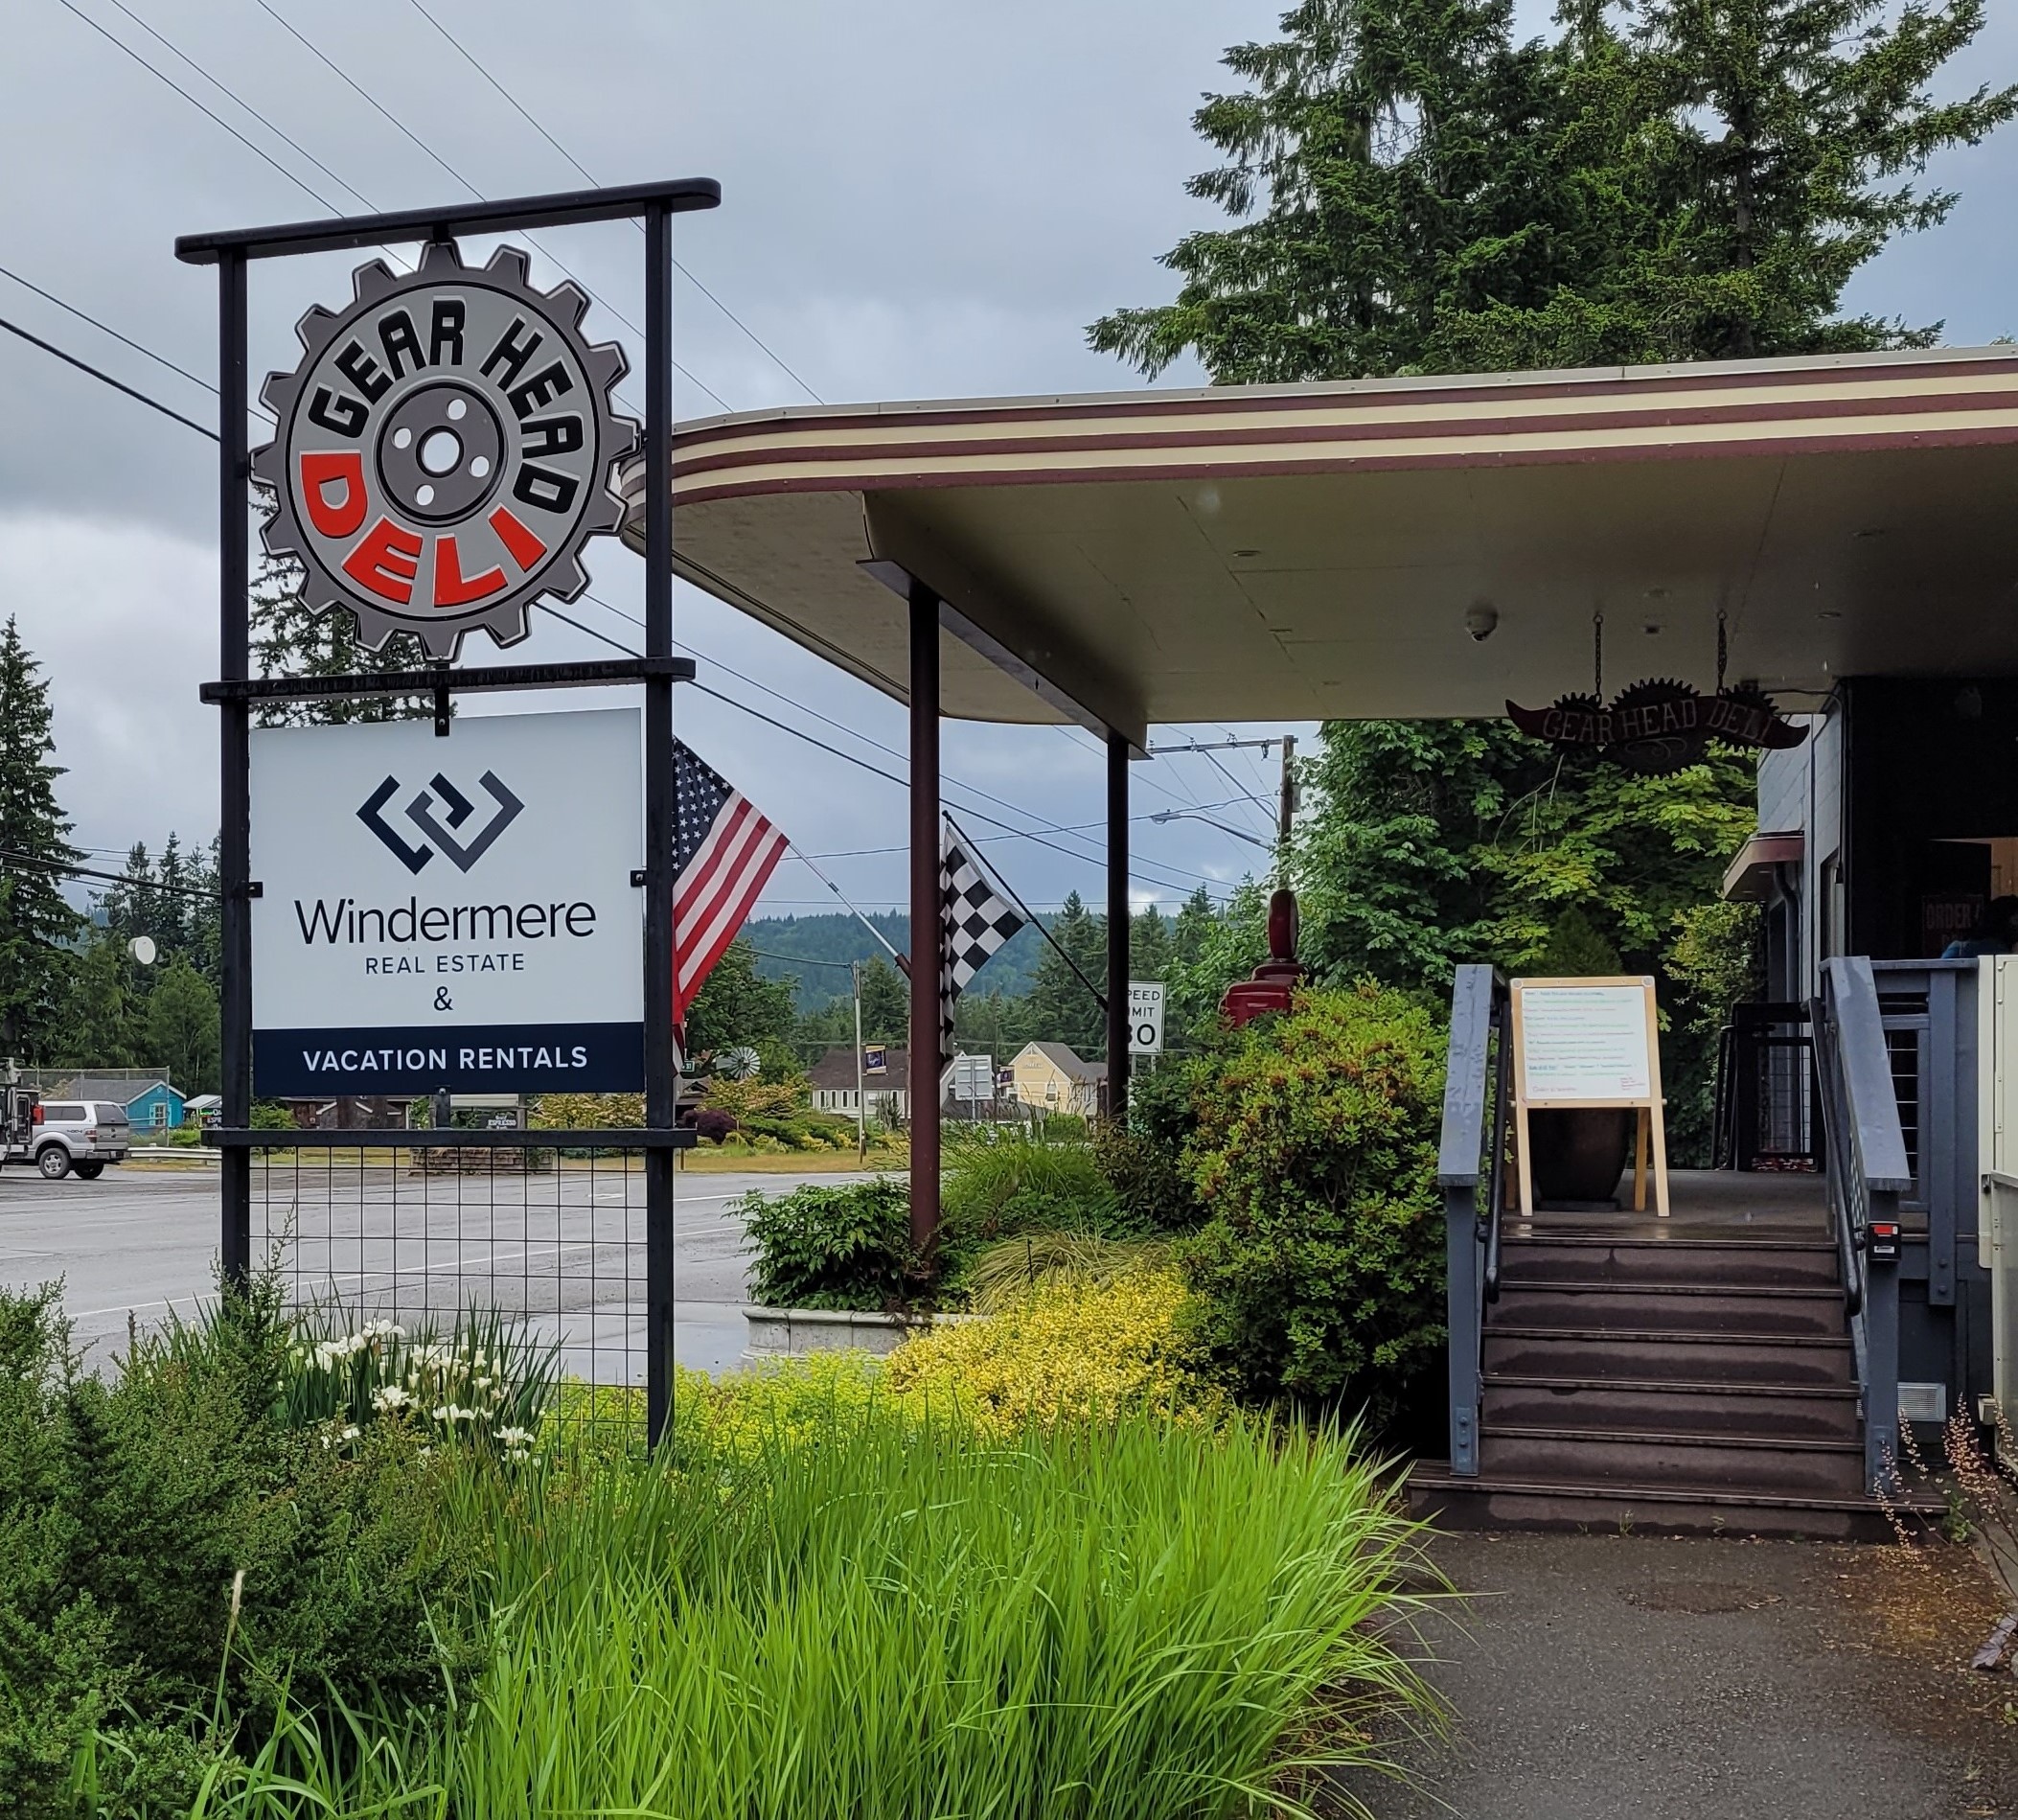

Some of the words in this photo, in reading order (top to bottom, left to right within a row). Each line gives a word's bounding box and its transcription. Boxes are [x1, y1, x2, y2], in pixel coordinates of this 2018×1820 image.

[309, 295, 467, 439] GEAR
[479, 311, 584, 515] HEAD
[301, 449, 548, 609] DELI
[1543, 709, 1615, 743] GEAR
[1619, 699, 1698, 737] HEAD
[1708, 699, 1777, 745] DELI
[294, 896, 597, 945] Windermere
[365, 956, 425, 975] REAL
[436, 953, 525, 974] ESTATE
[433, 985, 454, 1011] &
[1129, 1006, 1156, 1018] MIT
[303, 1048, 447, 1071] VACATION
[459, 1046, 588, 1070] RENTALS
